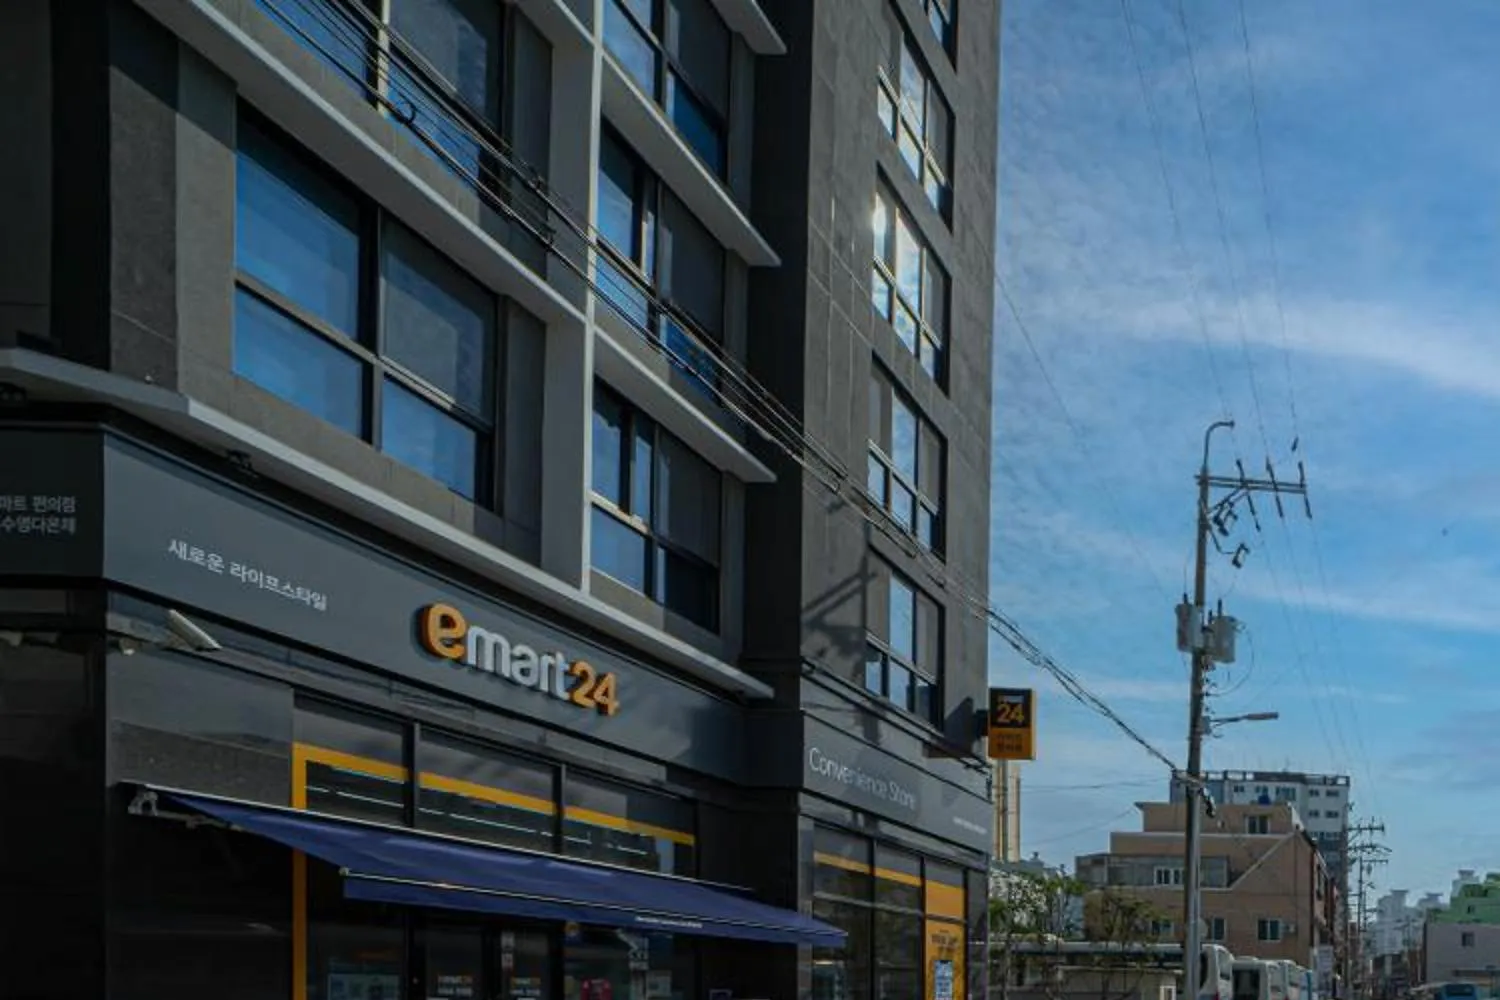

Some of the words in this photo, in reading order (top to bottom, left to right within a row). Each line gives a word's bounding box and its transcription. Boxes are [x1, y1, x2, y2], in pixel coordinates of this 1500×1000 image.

[168, 539, 225, 574] 새로운
[229, 562, 328, 612] 라이프스타일
[421, 602, 619, 717] emart24
[998, 703, 1024, 725] 24
